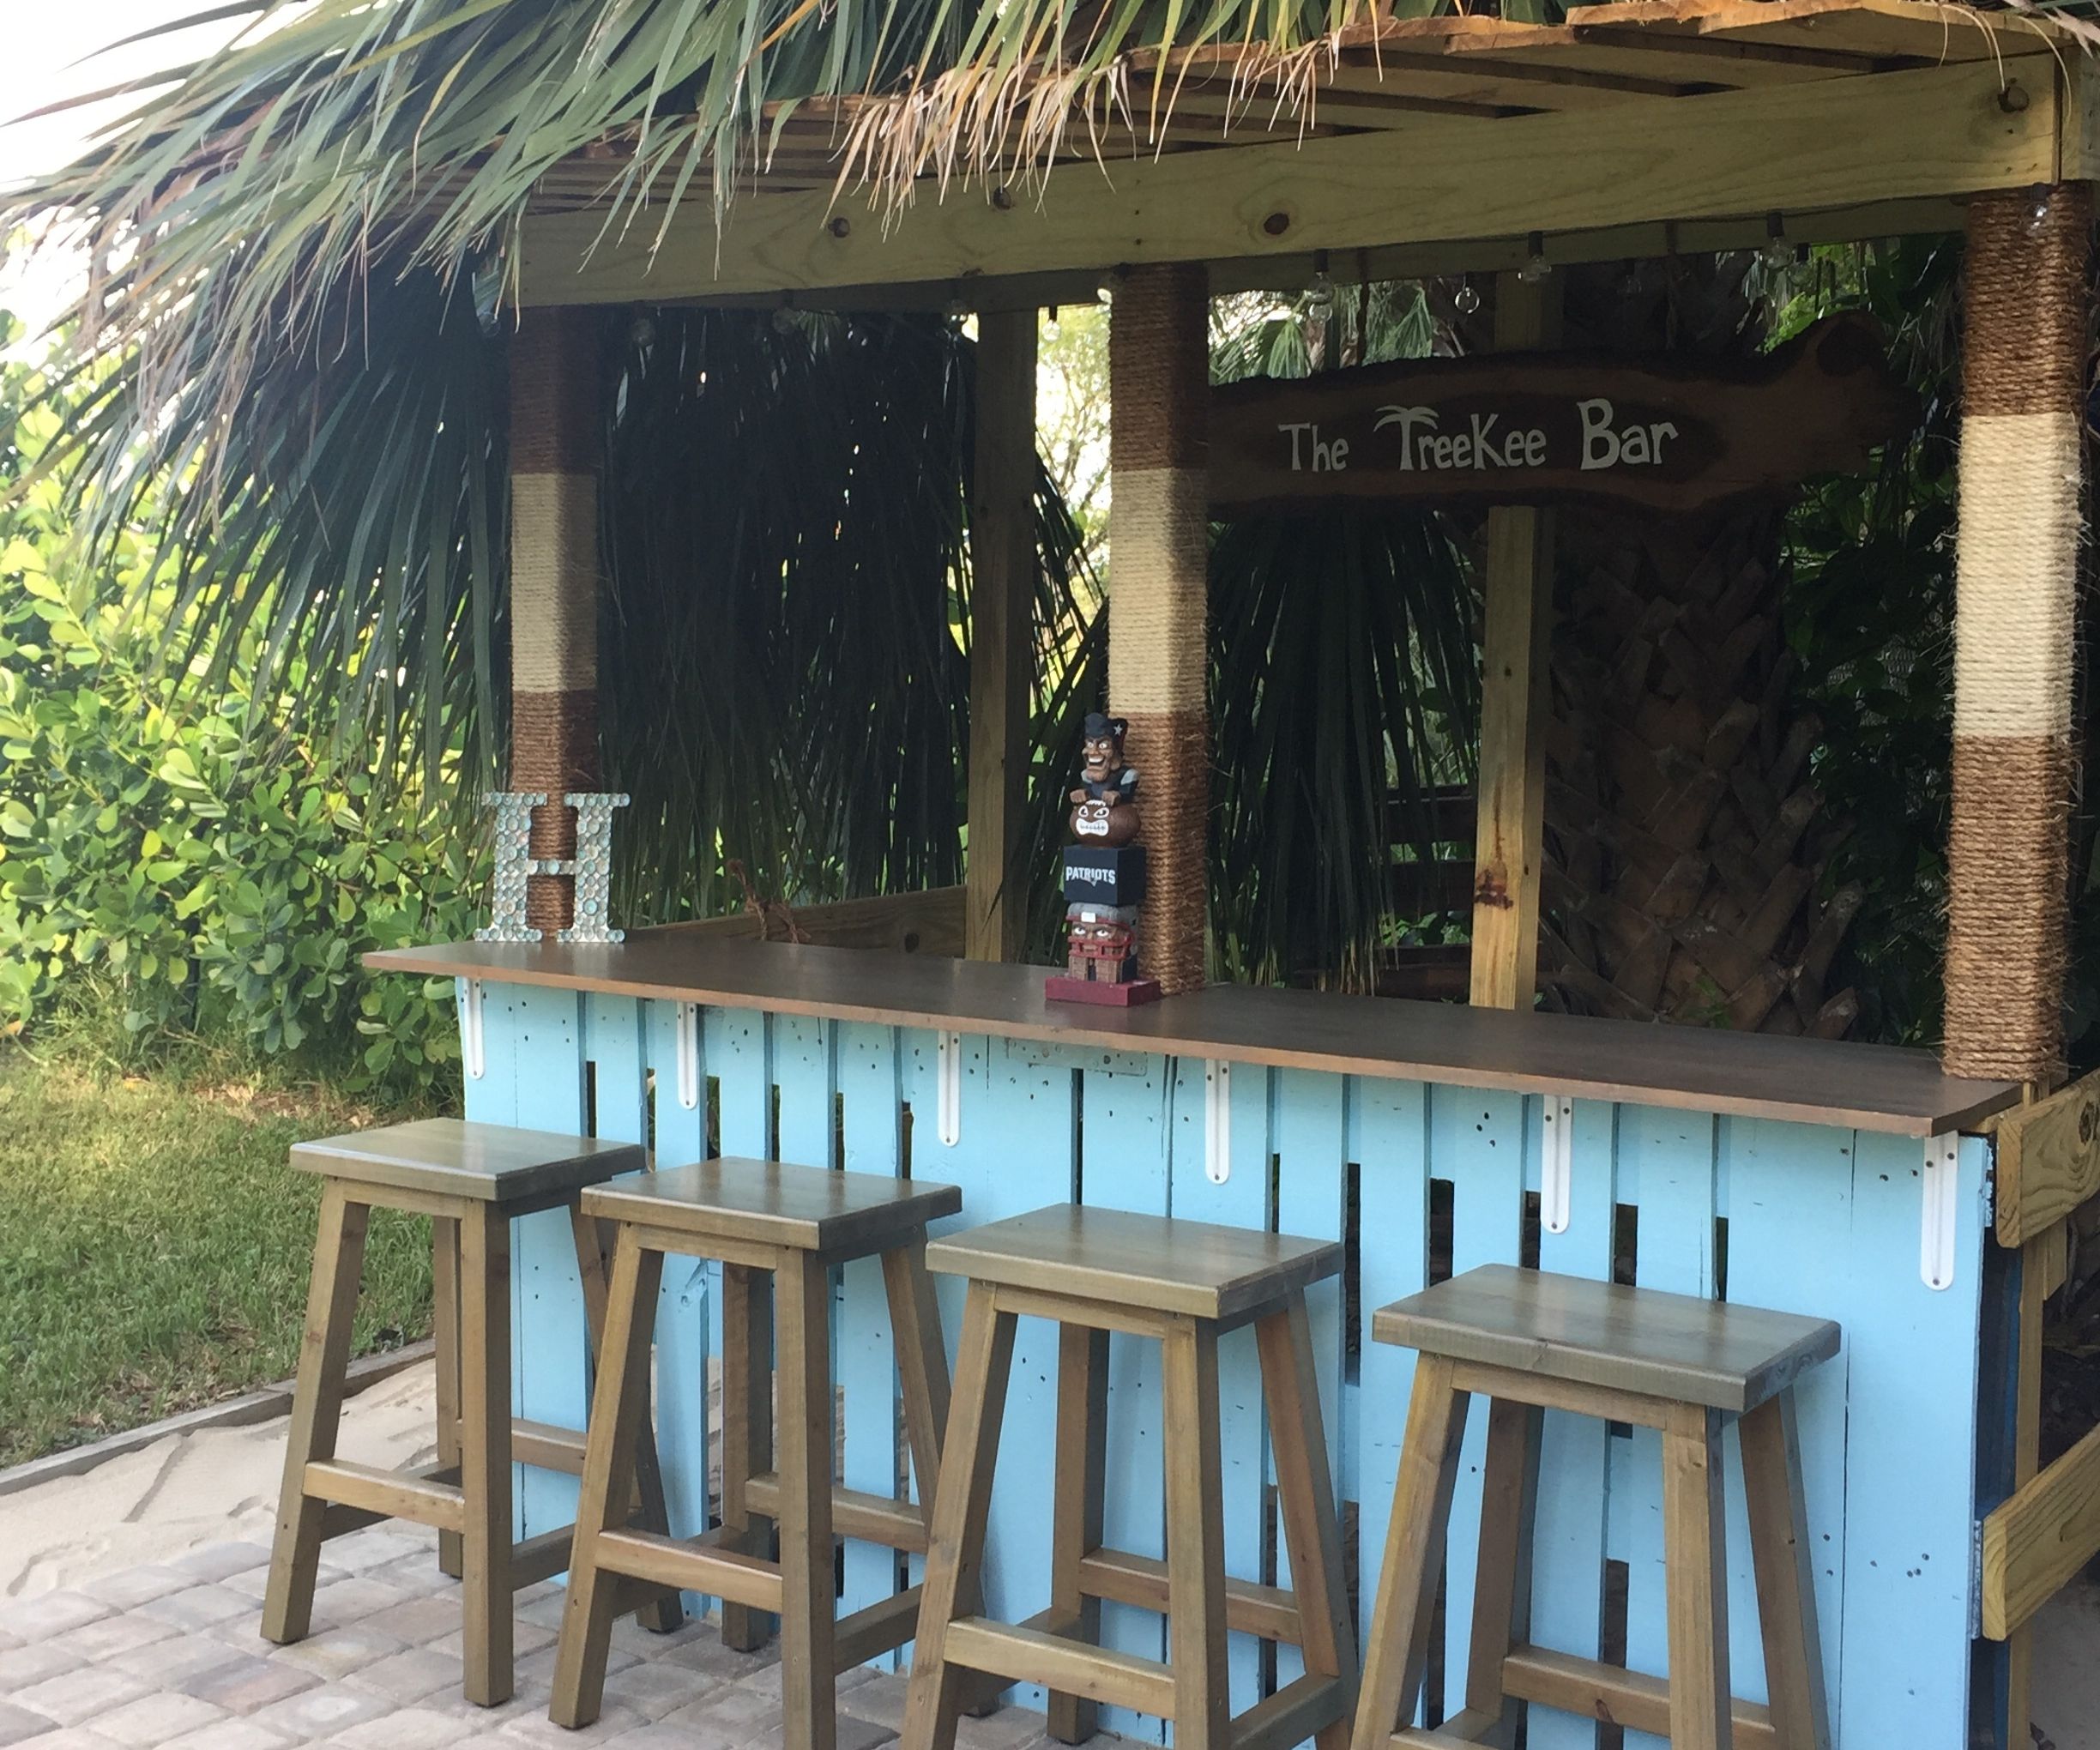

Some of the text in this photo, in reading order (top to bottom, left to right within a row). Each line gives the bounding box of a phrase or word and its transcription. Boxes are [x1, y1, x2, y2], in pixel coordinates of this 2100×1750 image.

[1278, 398, 1679, 472] The TreeKee Bar
[474, 792, 631, 943] H
[1065, 866, 1116, 885] PATRIOTS
